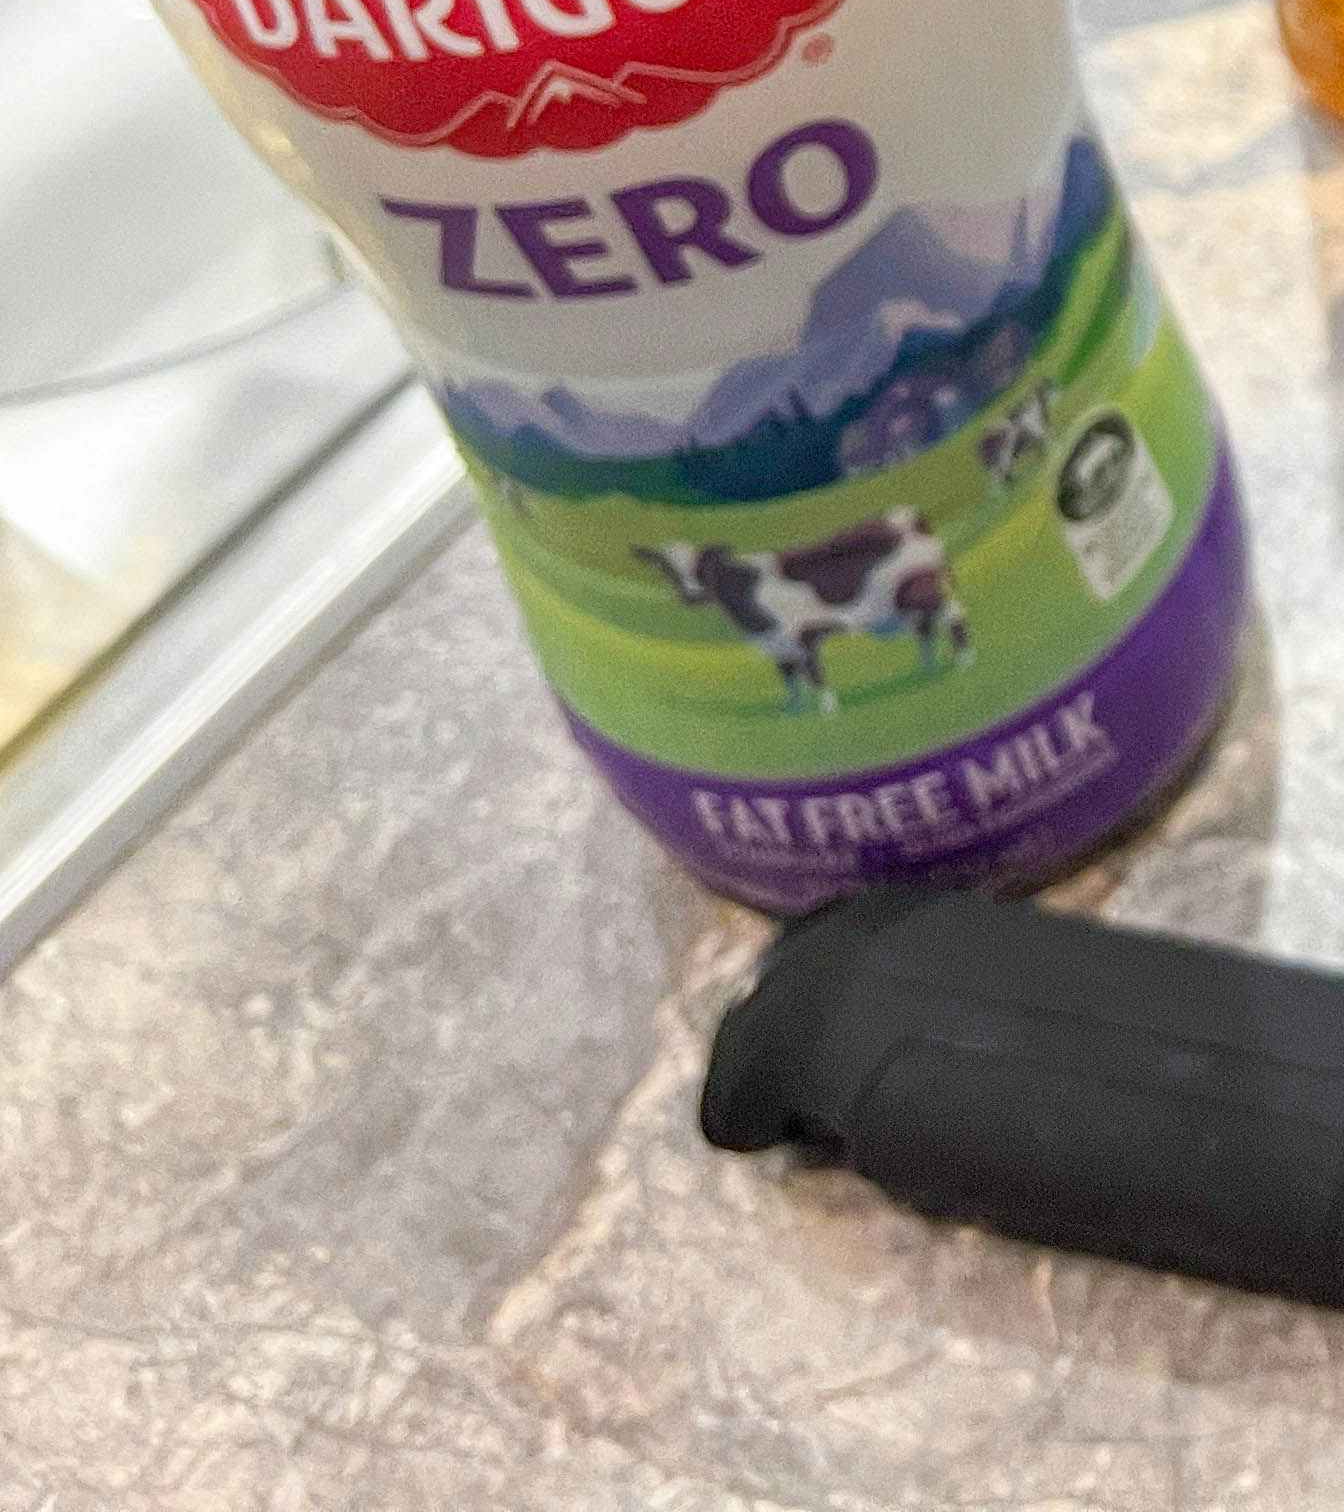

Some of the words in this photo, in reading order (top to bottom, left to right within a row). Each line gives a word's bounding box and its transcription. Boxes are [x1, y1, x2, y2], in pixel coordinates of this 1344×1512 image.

[379, 118, 881, 302] ZERO
[693, 790, 792, 845] FAT
[803, 770, 953, 845] FREE
[961, 690, 1110, 808] MILK
